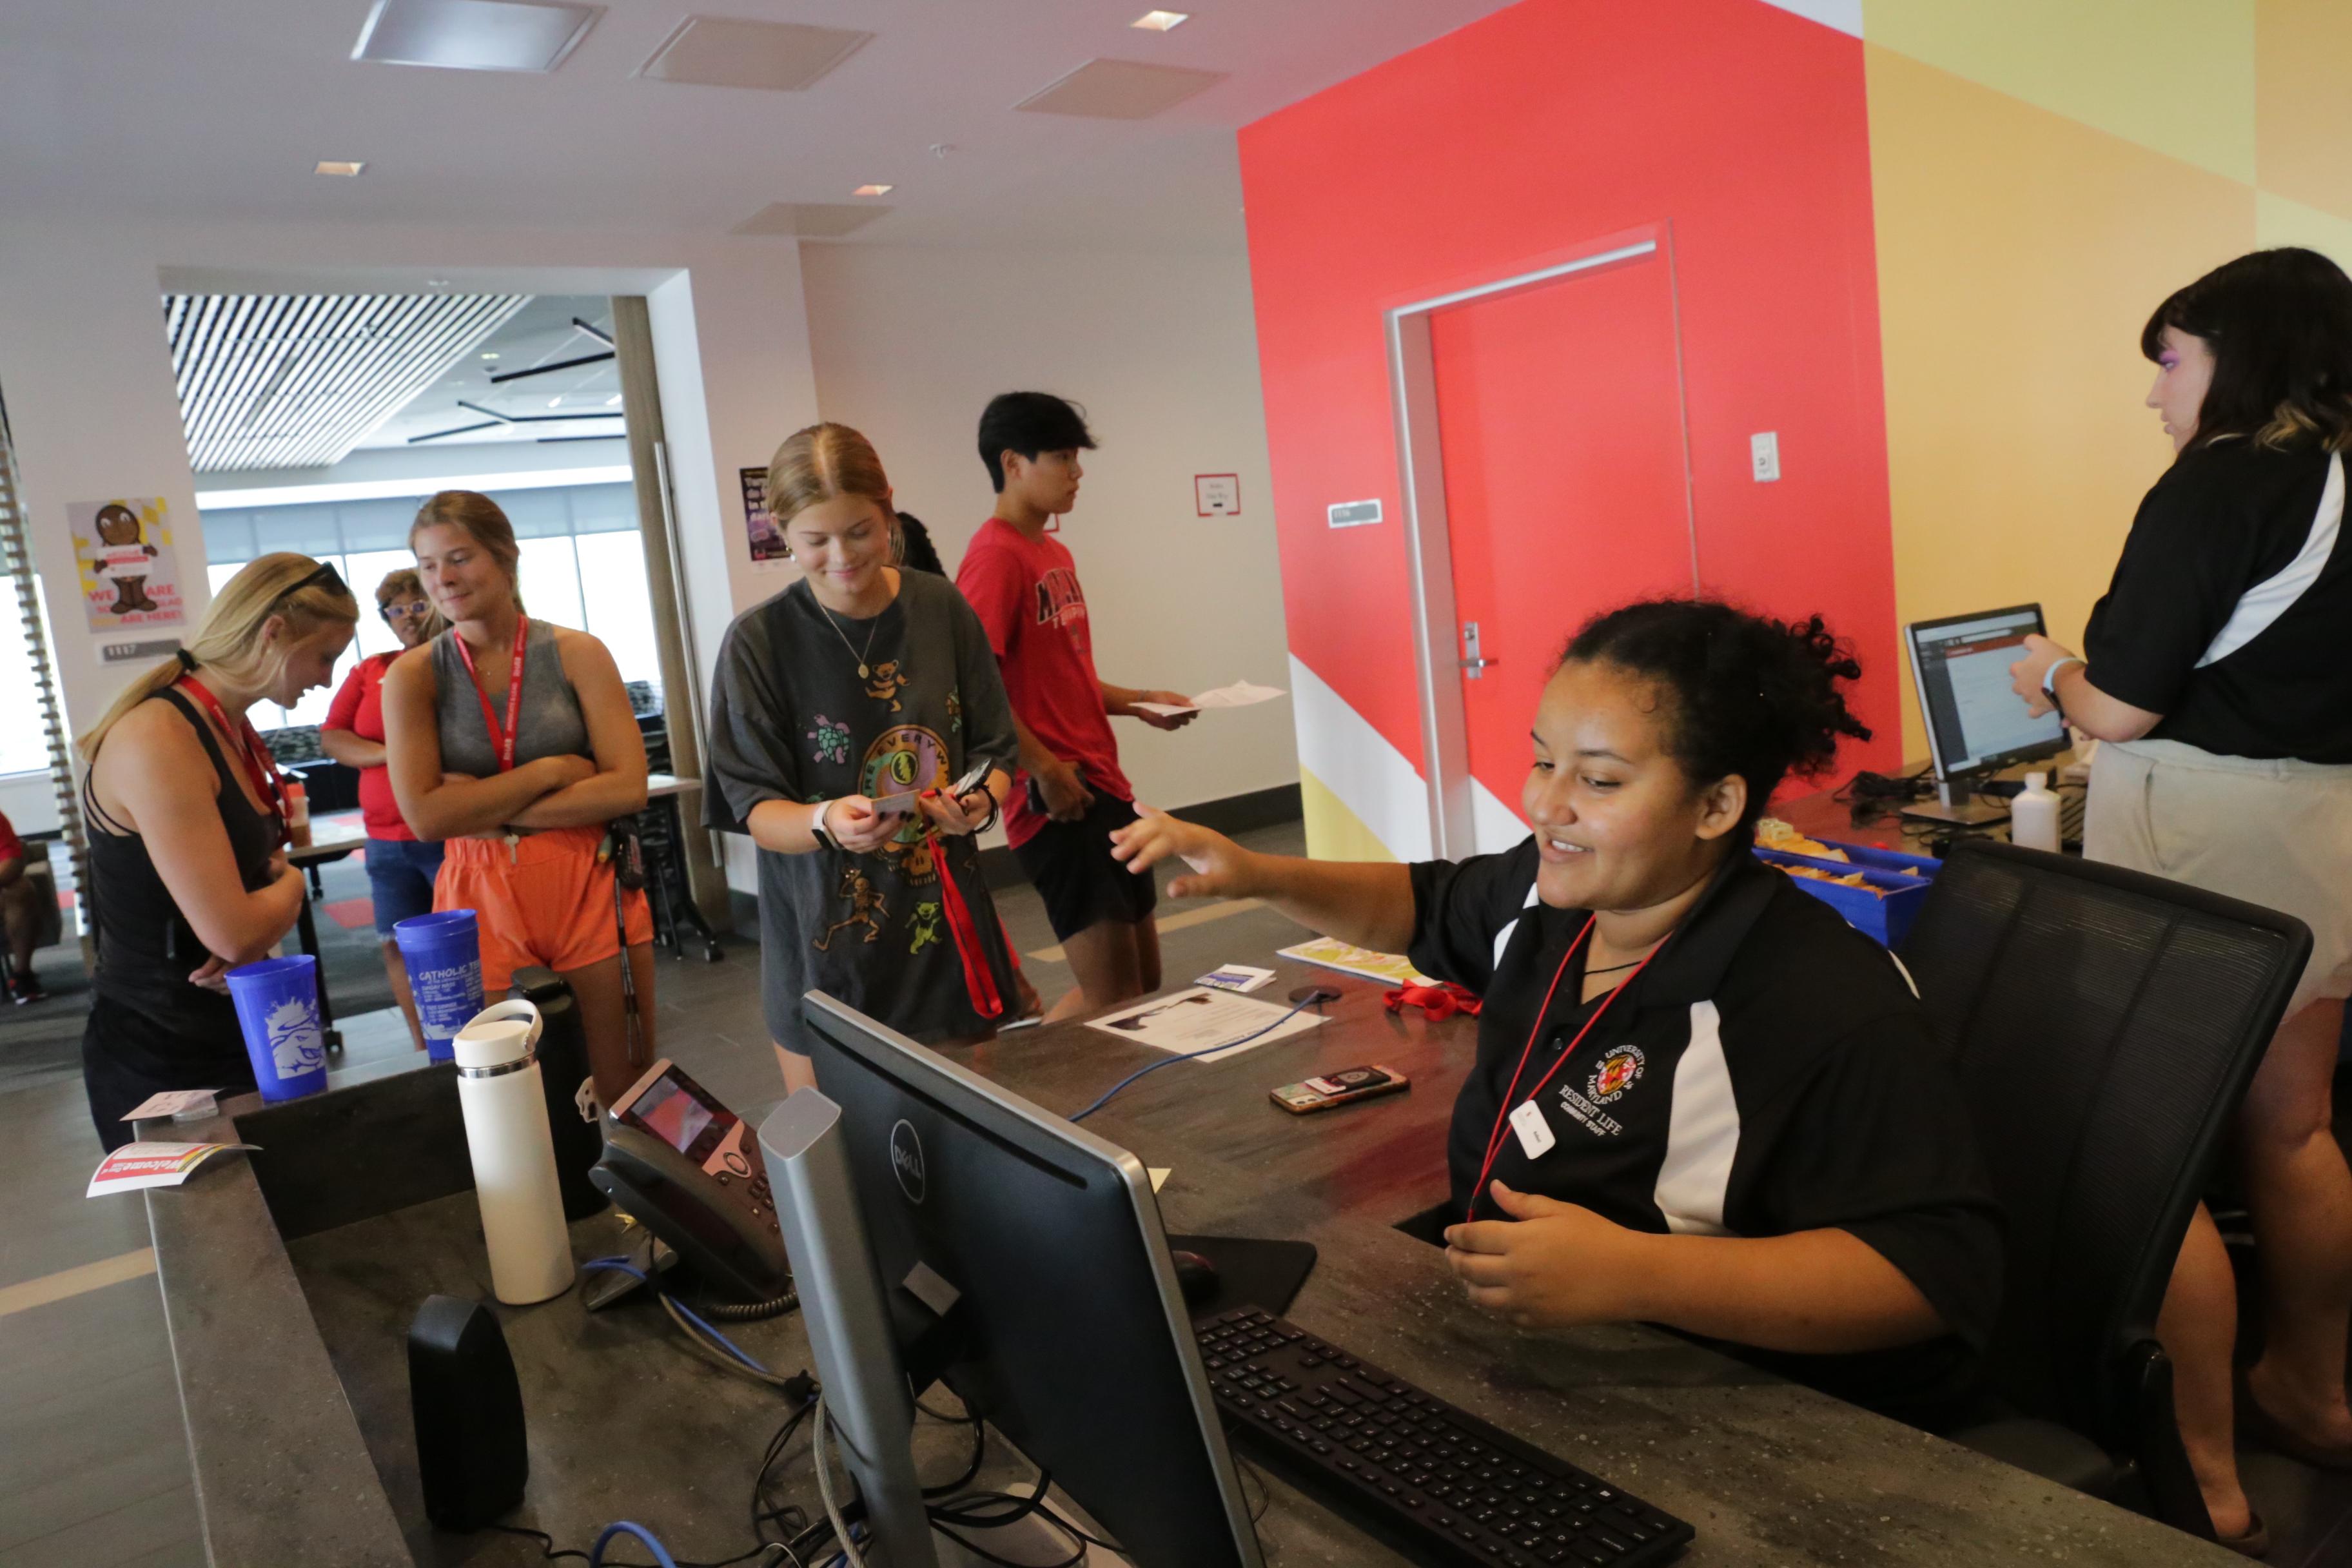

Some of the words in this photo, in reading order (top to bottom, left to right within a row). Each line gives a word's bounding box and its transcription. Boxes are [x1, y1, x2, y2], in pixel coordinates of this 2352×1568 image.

[88, 589, 114, 602] WE
[146, 584, 175, 596] ARE
[108, 644, 137, 656] 1117
[419, 965, 467, 981] CATHOLIC
[1605, 1045, 1645, 1064] UNIVERSITY
[1634, 1067, 1644, 1079] OF
[1587, 1075, 1623, 1104] MARYLAND
[1558, 1084, 1600, 1117] RESIDENT
[1596, 1113, 1623, 1135] LIFE
[1585, 1120, 1607, 1136] STAFF
[122, 1159, 184, 1171] Welcome
[894, 1144, 922, 1180] DELL
